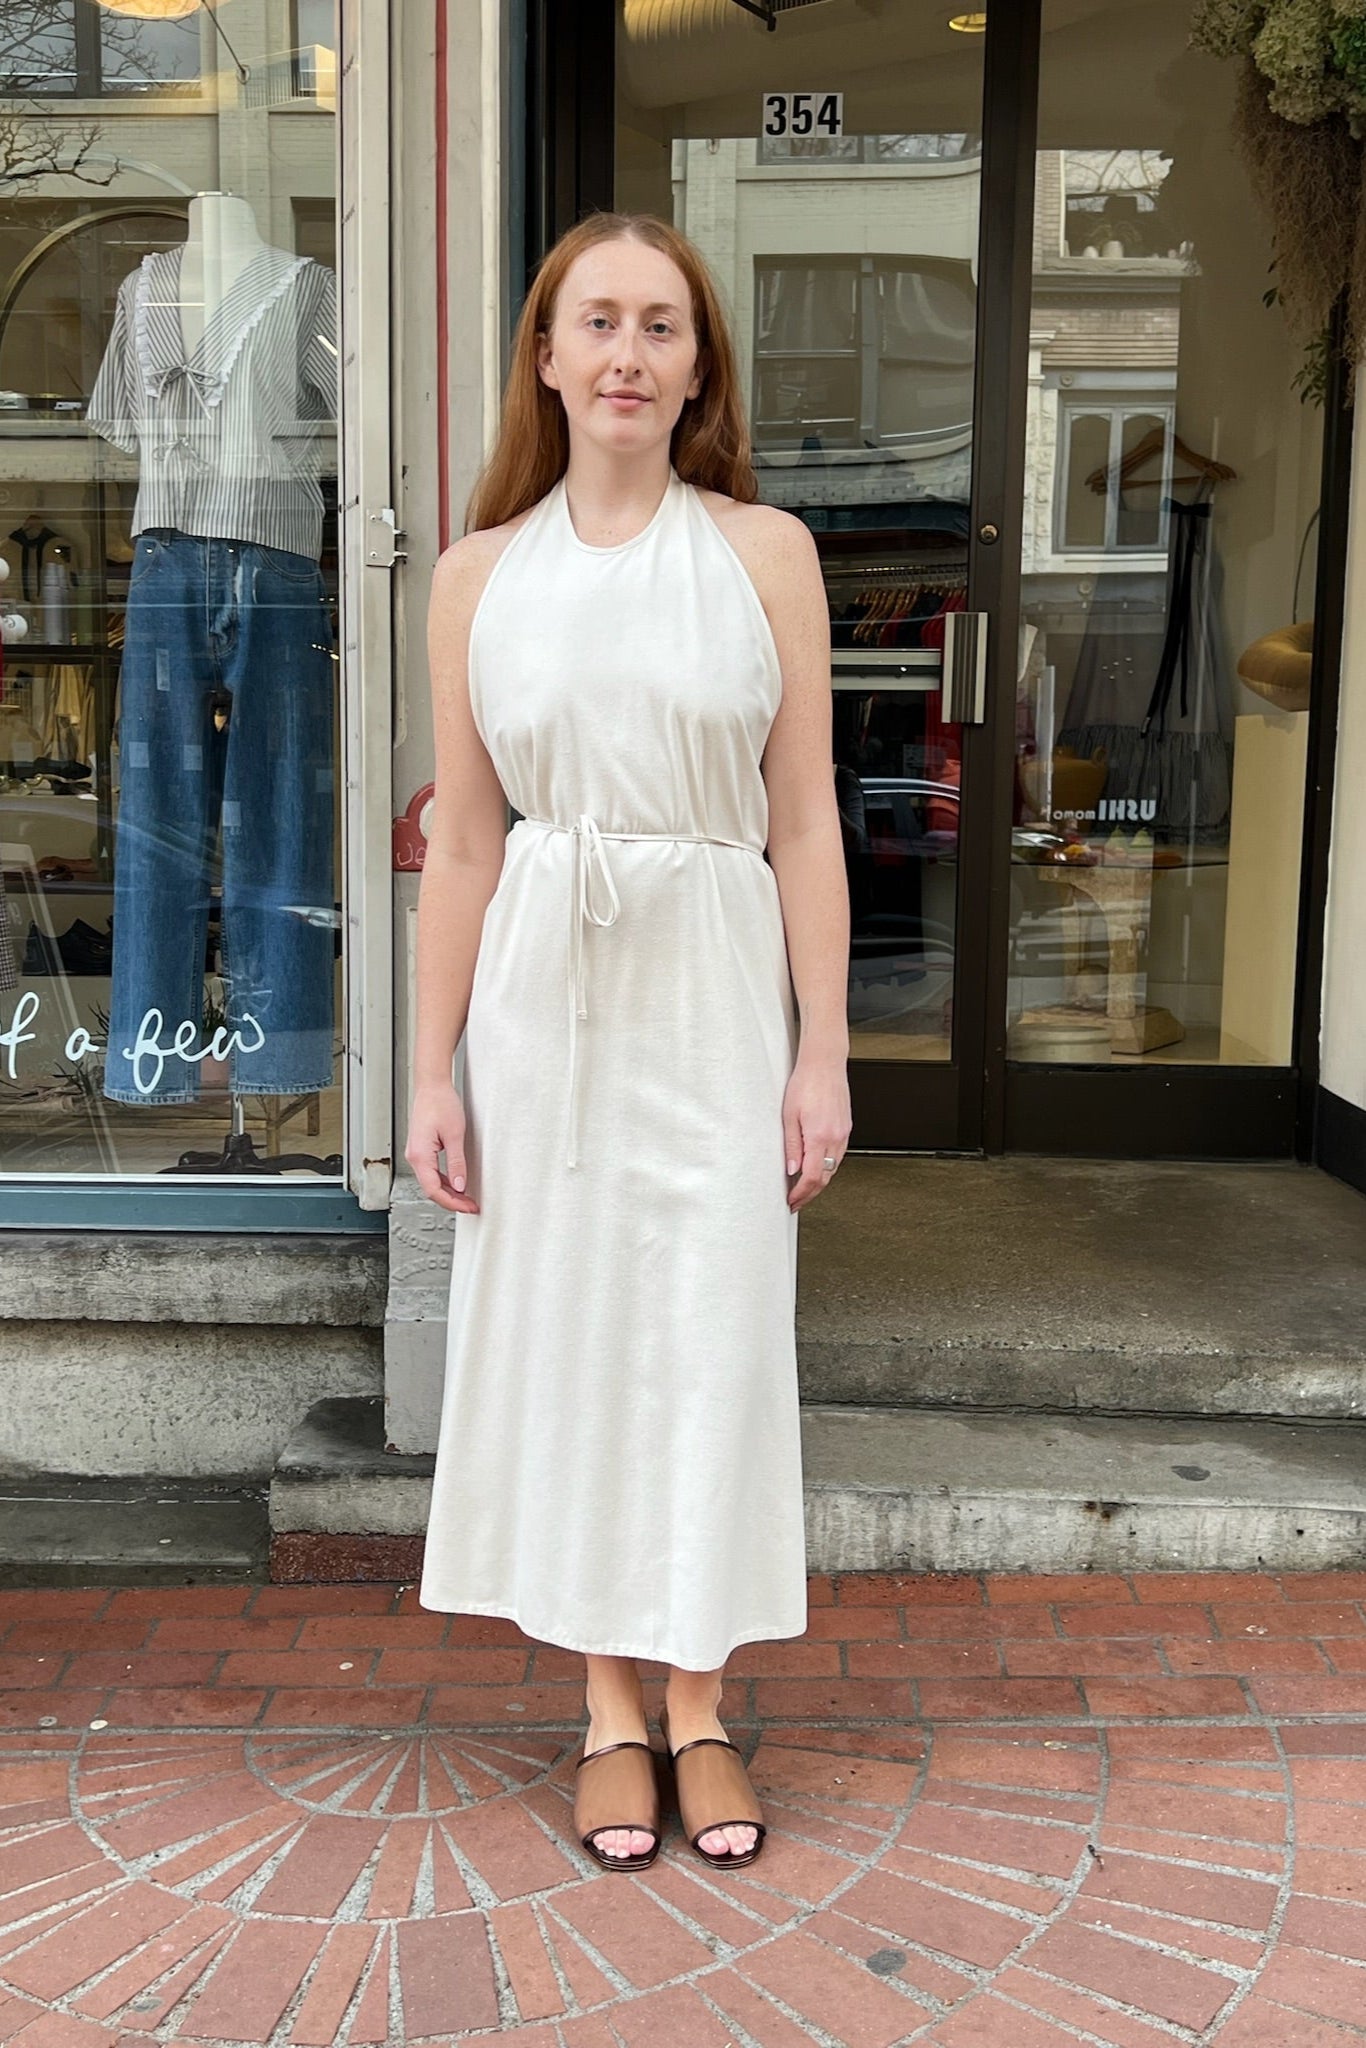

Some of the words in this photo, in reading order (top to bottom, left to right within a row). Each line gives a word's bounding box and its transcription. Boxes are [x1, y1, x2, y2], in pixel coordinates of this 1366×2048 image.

[765, 95, 841, 136] 354
[0, 991, 40, 1080] f
[65, 1027, 100, 1062] a
[122, 1008, 266, 1095] few
